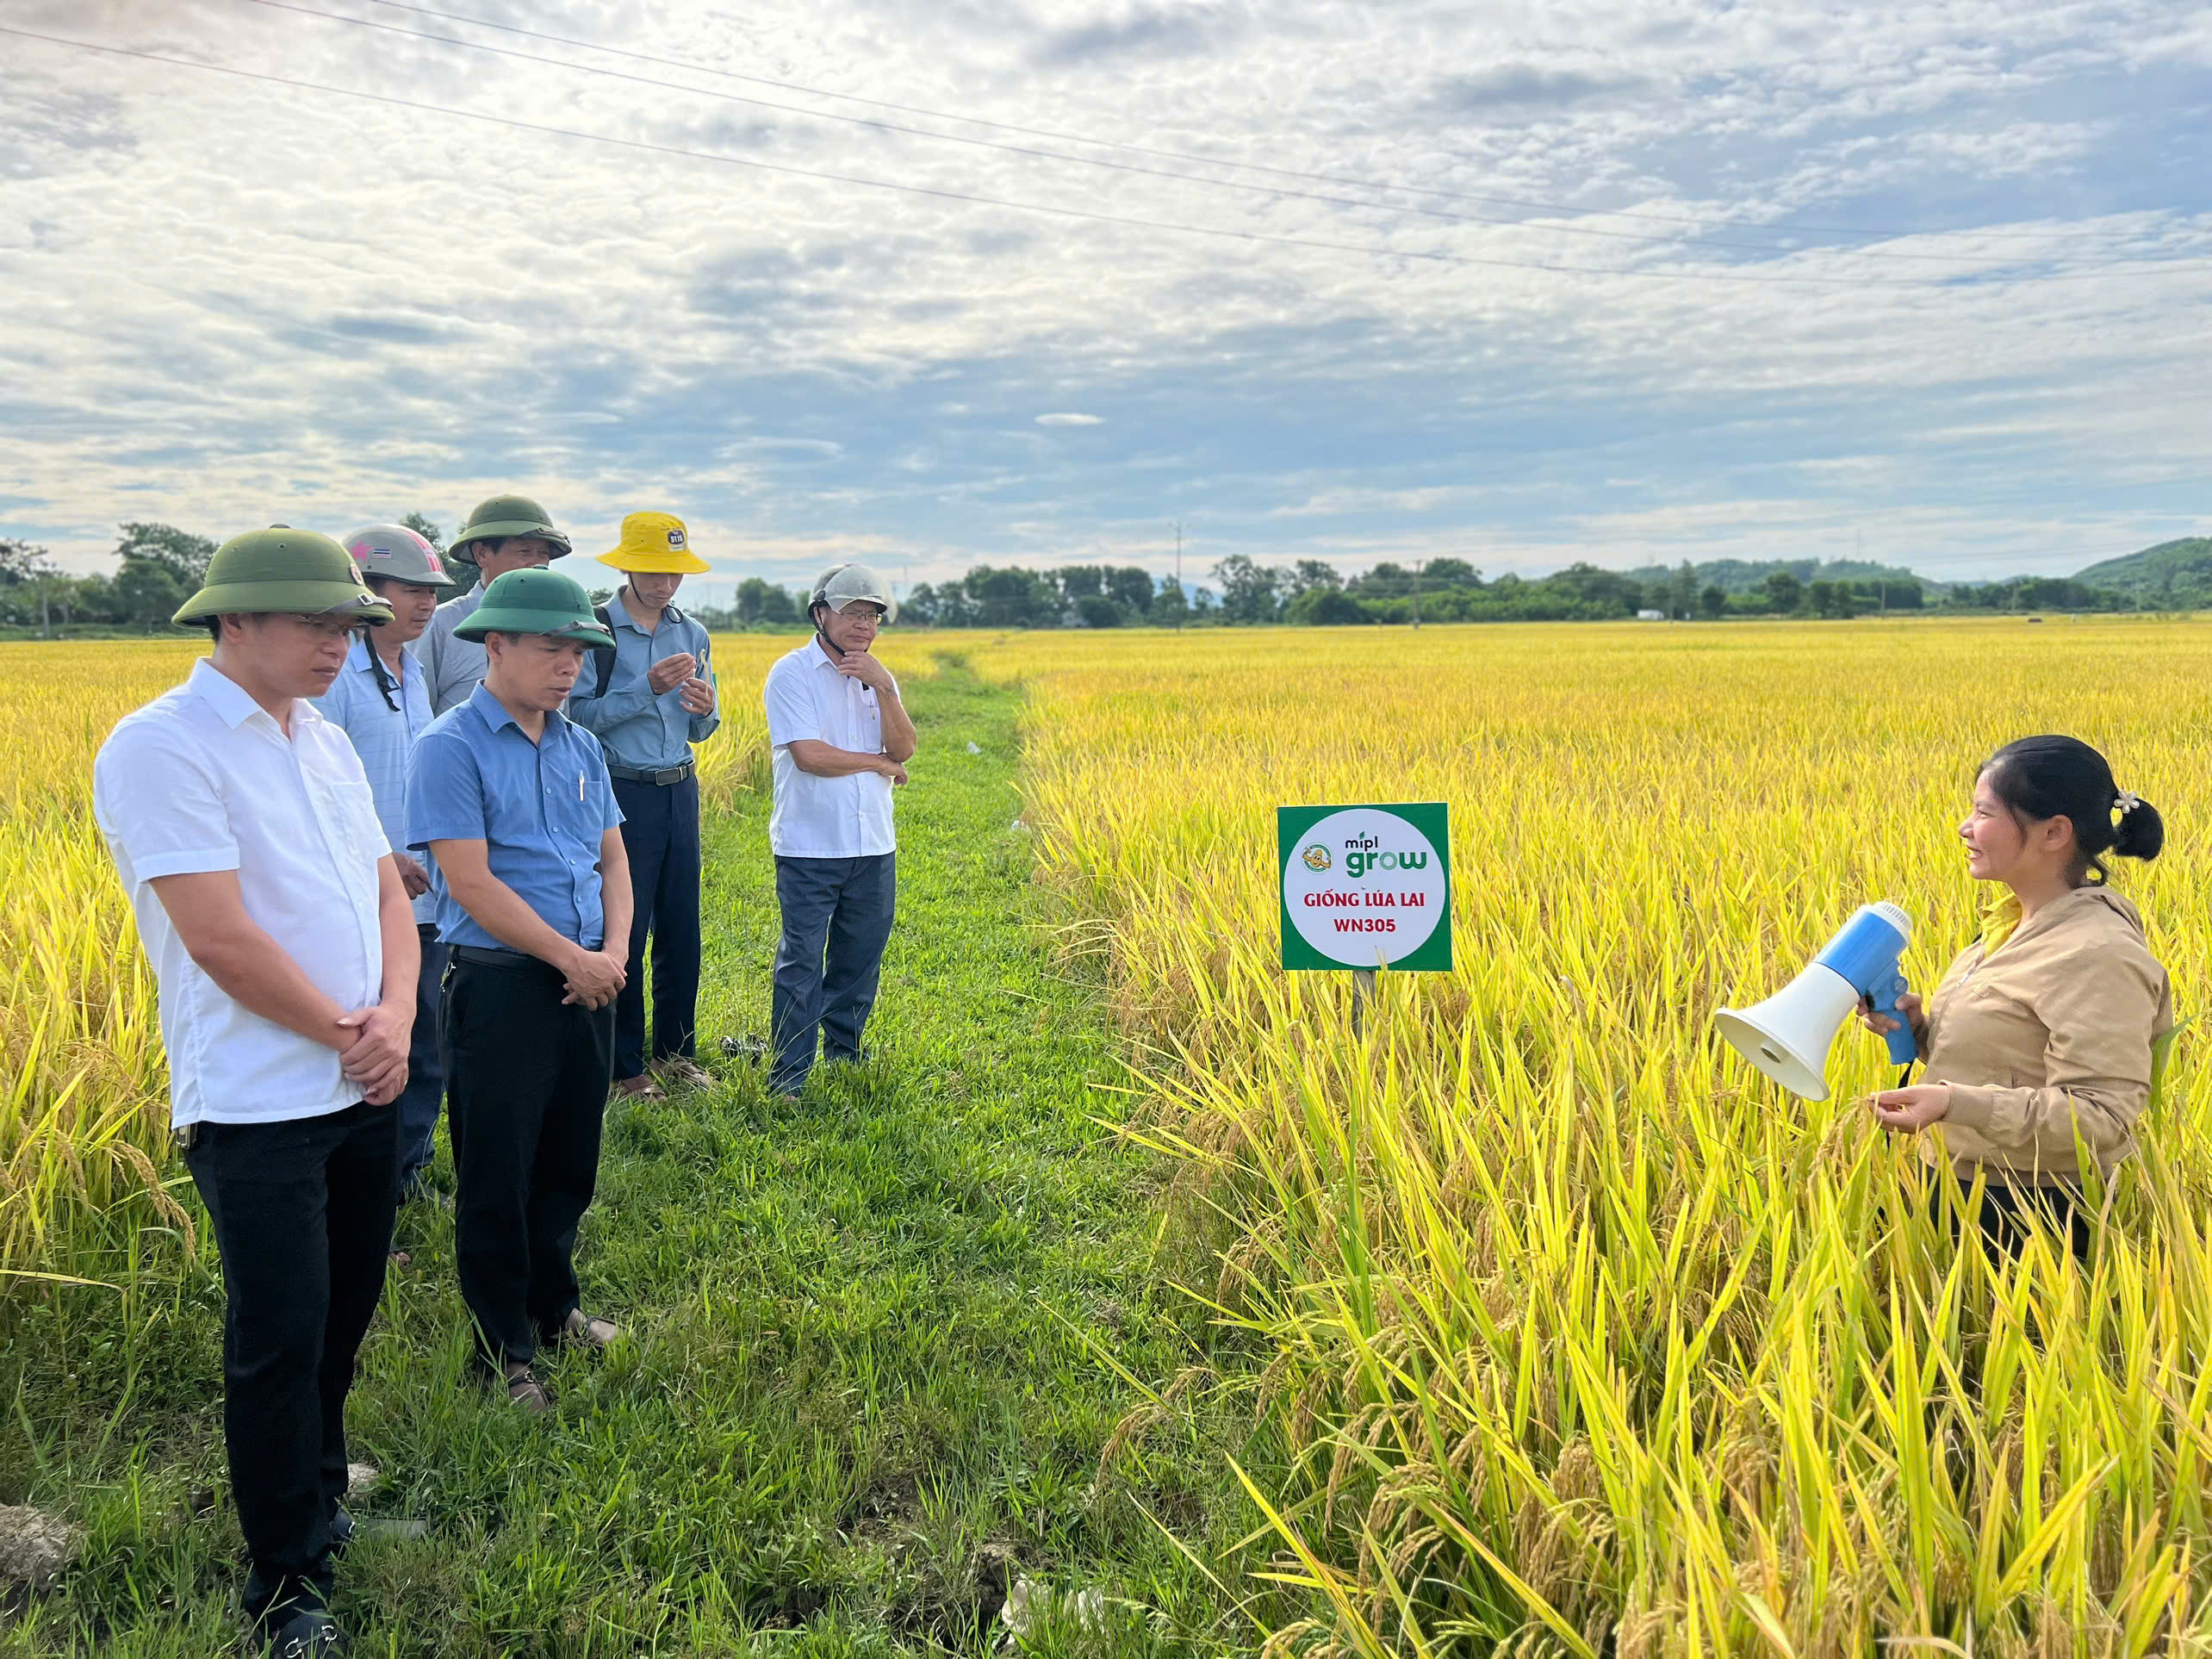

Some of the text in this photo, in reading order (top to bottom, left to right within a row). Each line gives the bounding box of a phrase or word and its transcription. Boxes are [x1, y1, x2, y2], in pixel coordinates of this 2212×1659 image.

[1345, 833, 1378, 851] mipl
[1345, 851, 1426, 878] grow
[1304, 889, 1425, 907] GIỐNG LÚA LAI
[1333, 918, 1396, 932] WN305
